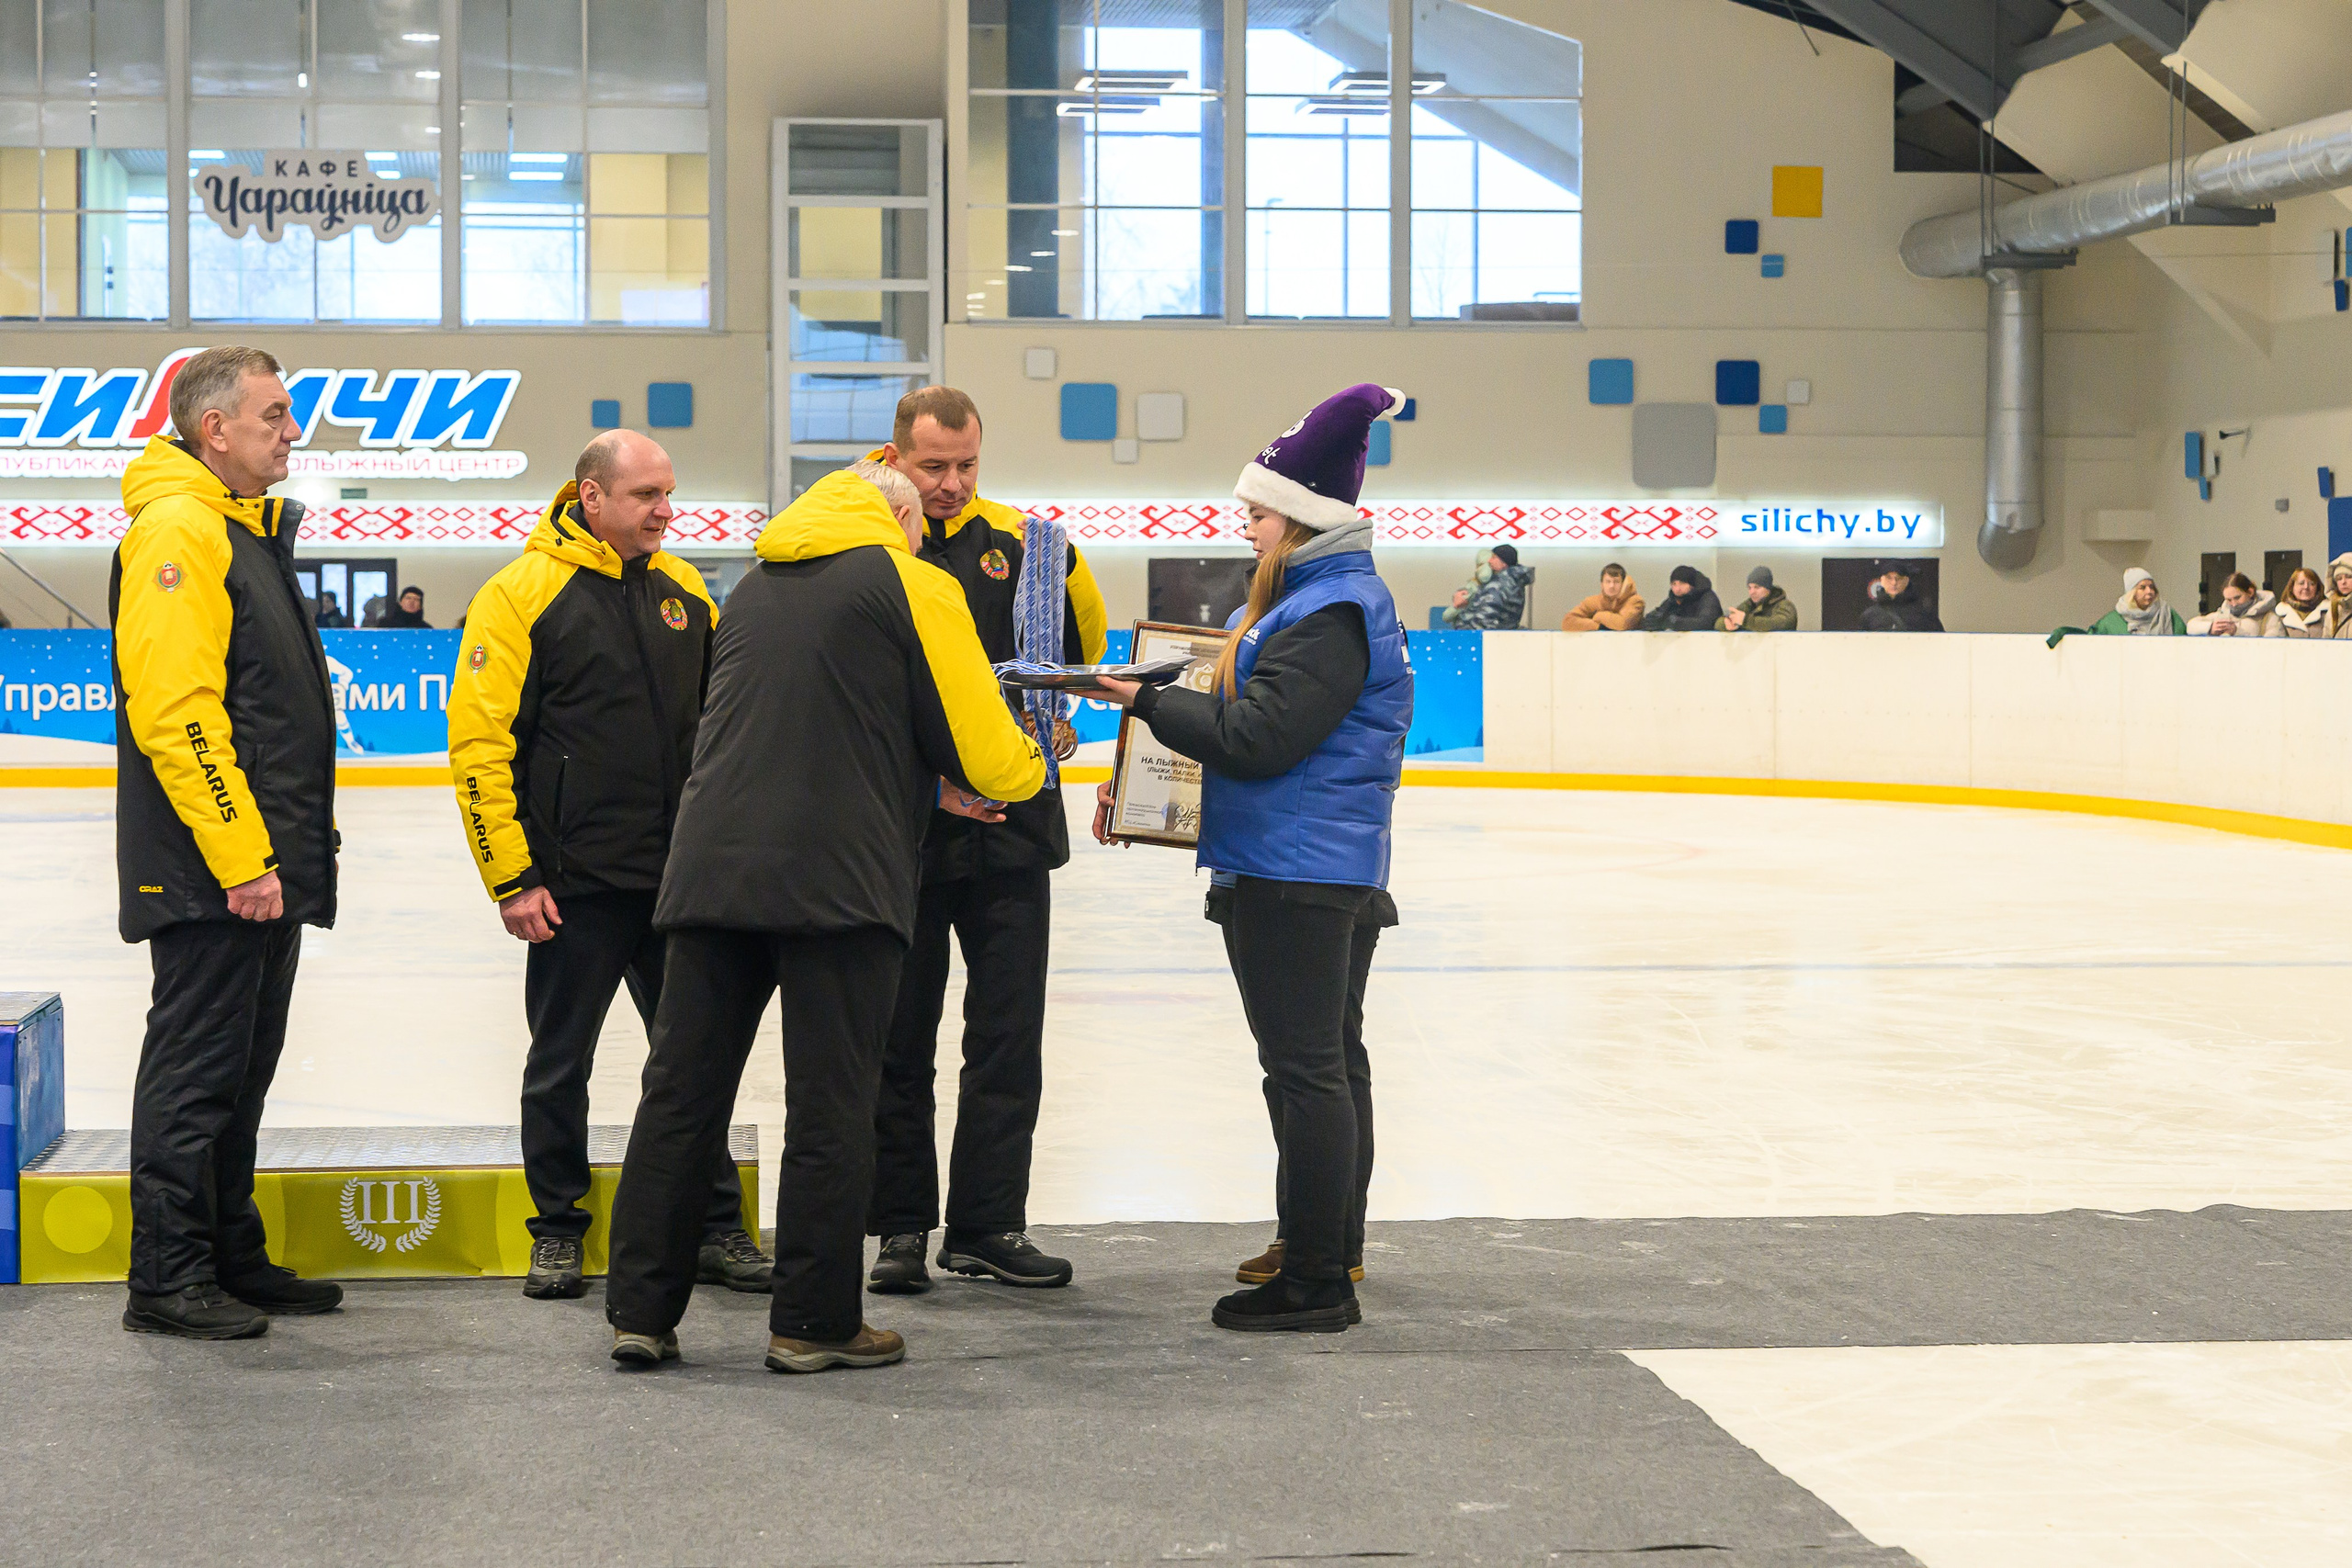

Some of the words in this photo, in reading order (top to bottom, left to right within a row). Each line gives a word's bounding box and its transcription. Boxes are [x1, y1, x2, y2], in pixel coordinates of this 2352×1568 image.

[276, 160, 357, 177] КАФЕ
[204, 175, 429, 233] Чараўніца
[439, 457, 520, 472] ЦЕНТР
[1741, 508, 1921, 539] silichy.by
[186, 721, 238, 823] BELARUS
[1140, 756, 1154, 764] НА
[466, 776, 494, 863] BELARUS
[356, 1180, 424, 1224] III
